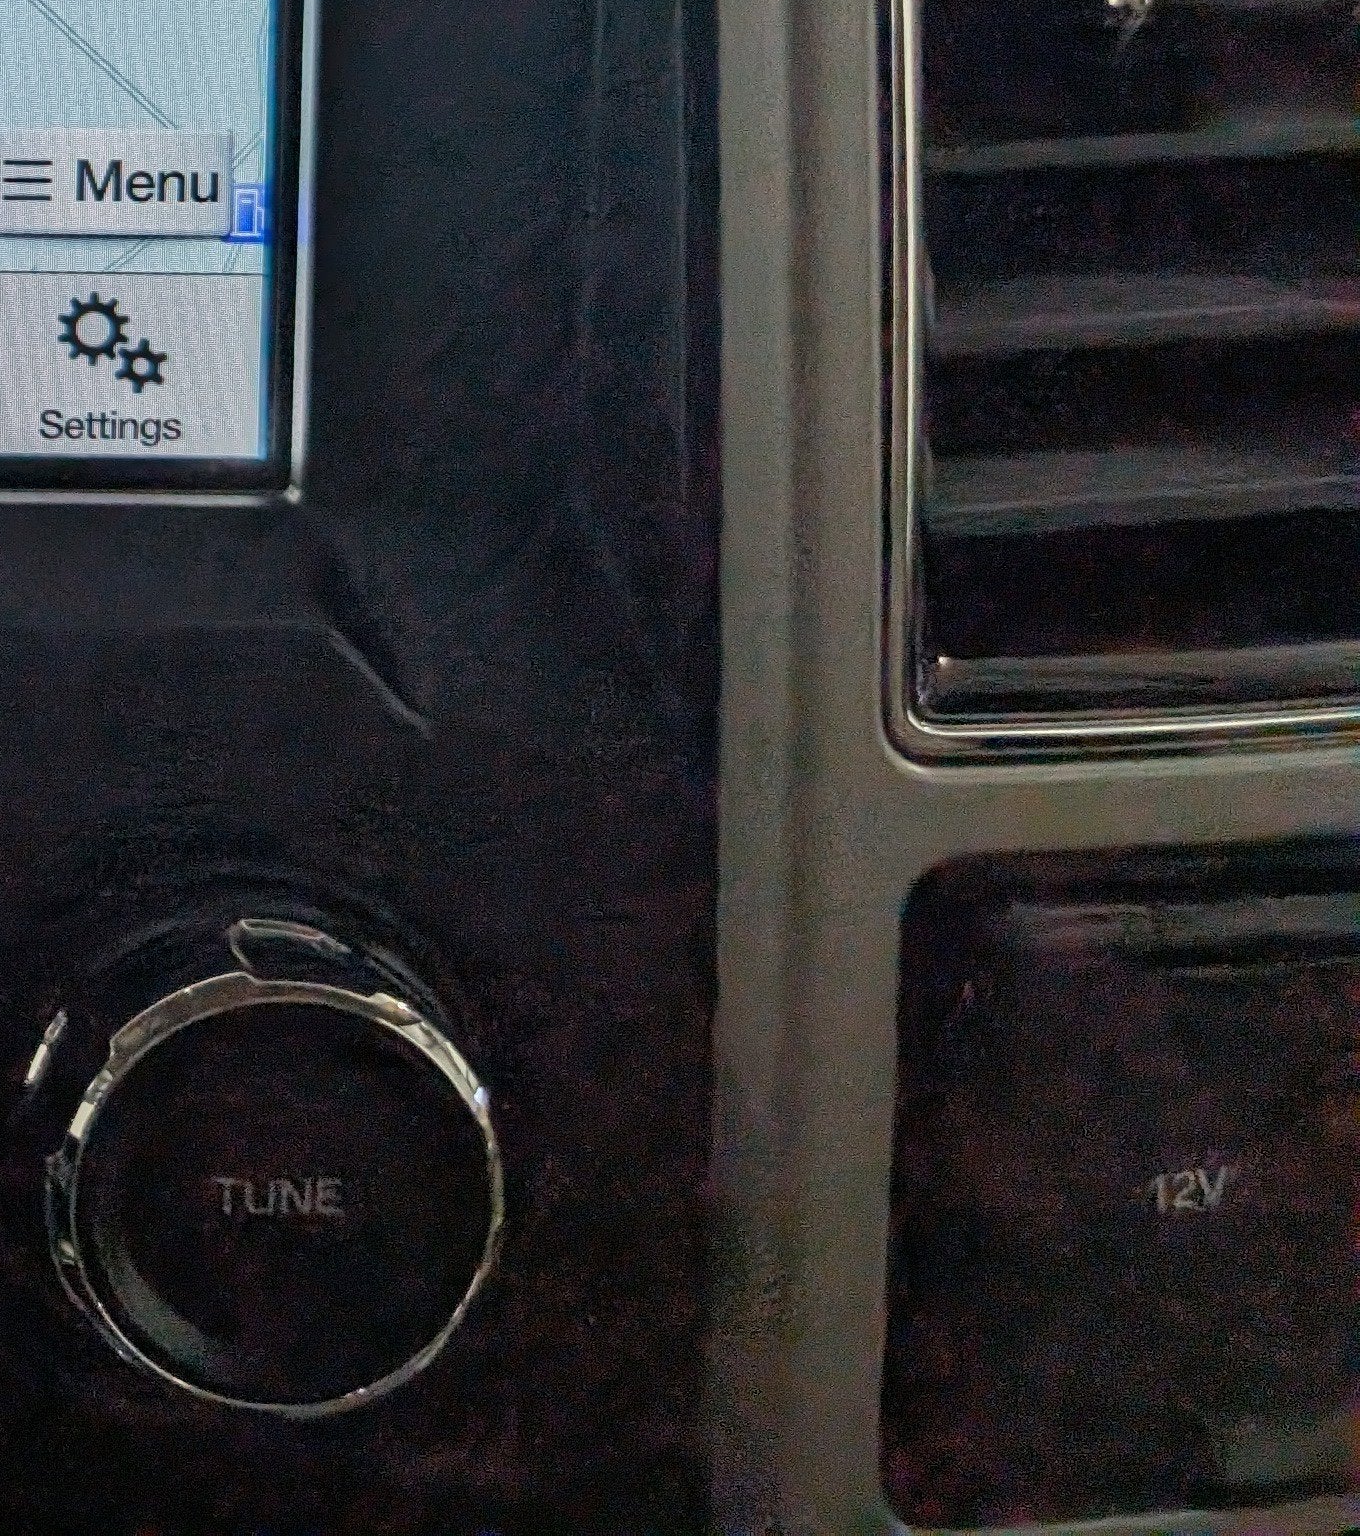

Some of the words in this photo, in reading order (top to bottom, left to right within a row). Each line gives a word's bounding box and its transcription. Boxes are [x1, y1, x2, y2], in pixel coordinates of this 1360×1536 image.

[76, 161, 220, 204] Menu
[38, 409, 182, 446] Settings
[213, 1175, 346, 1218] TUNE
[1154, 1165, 1233, 1212] 12V
